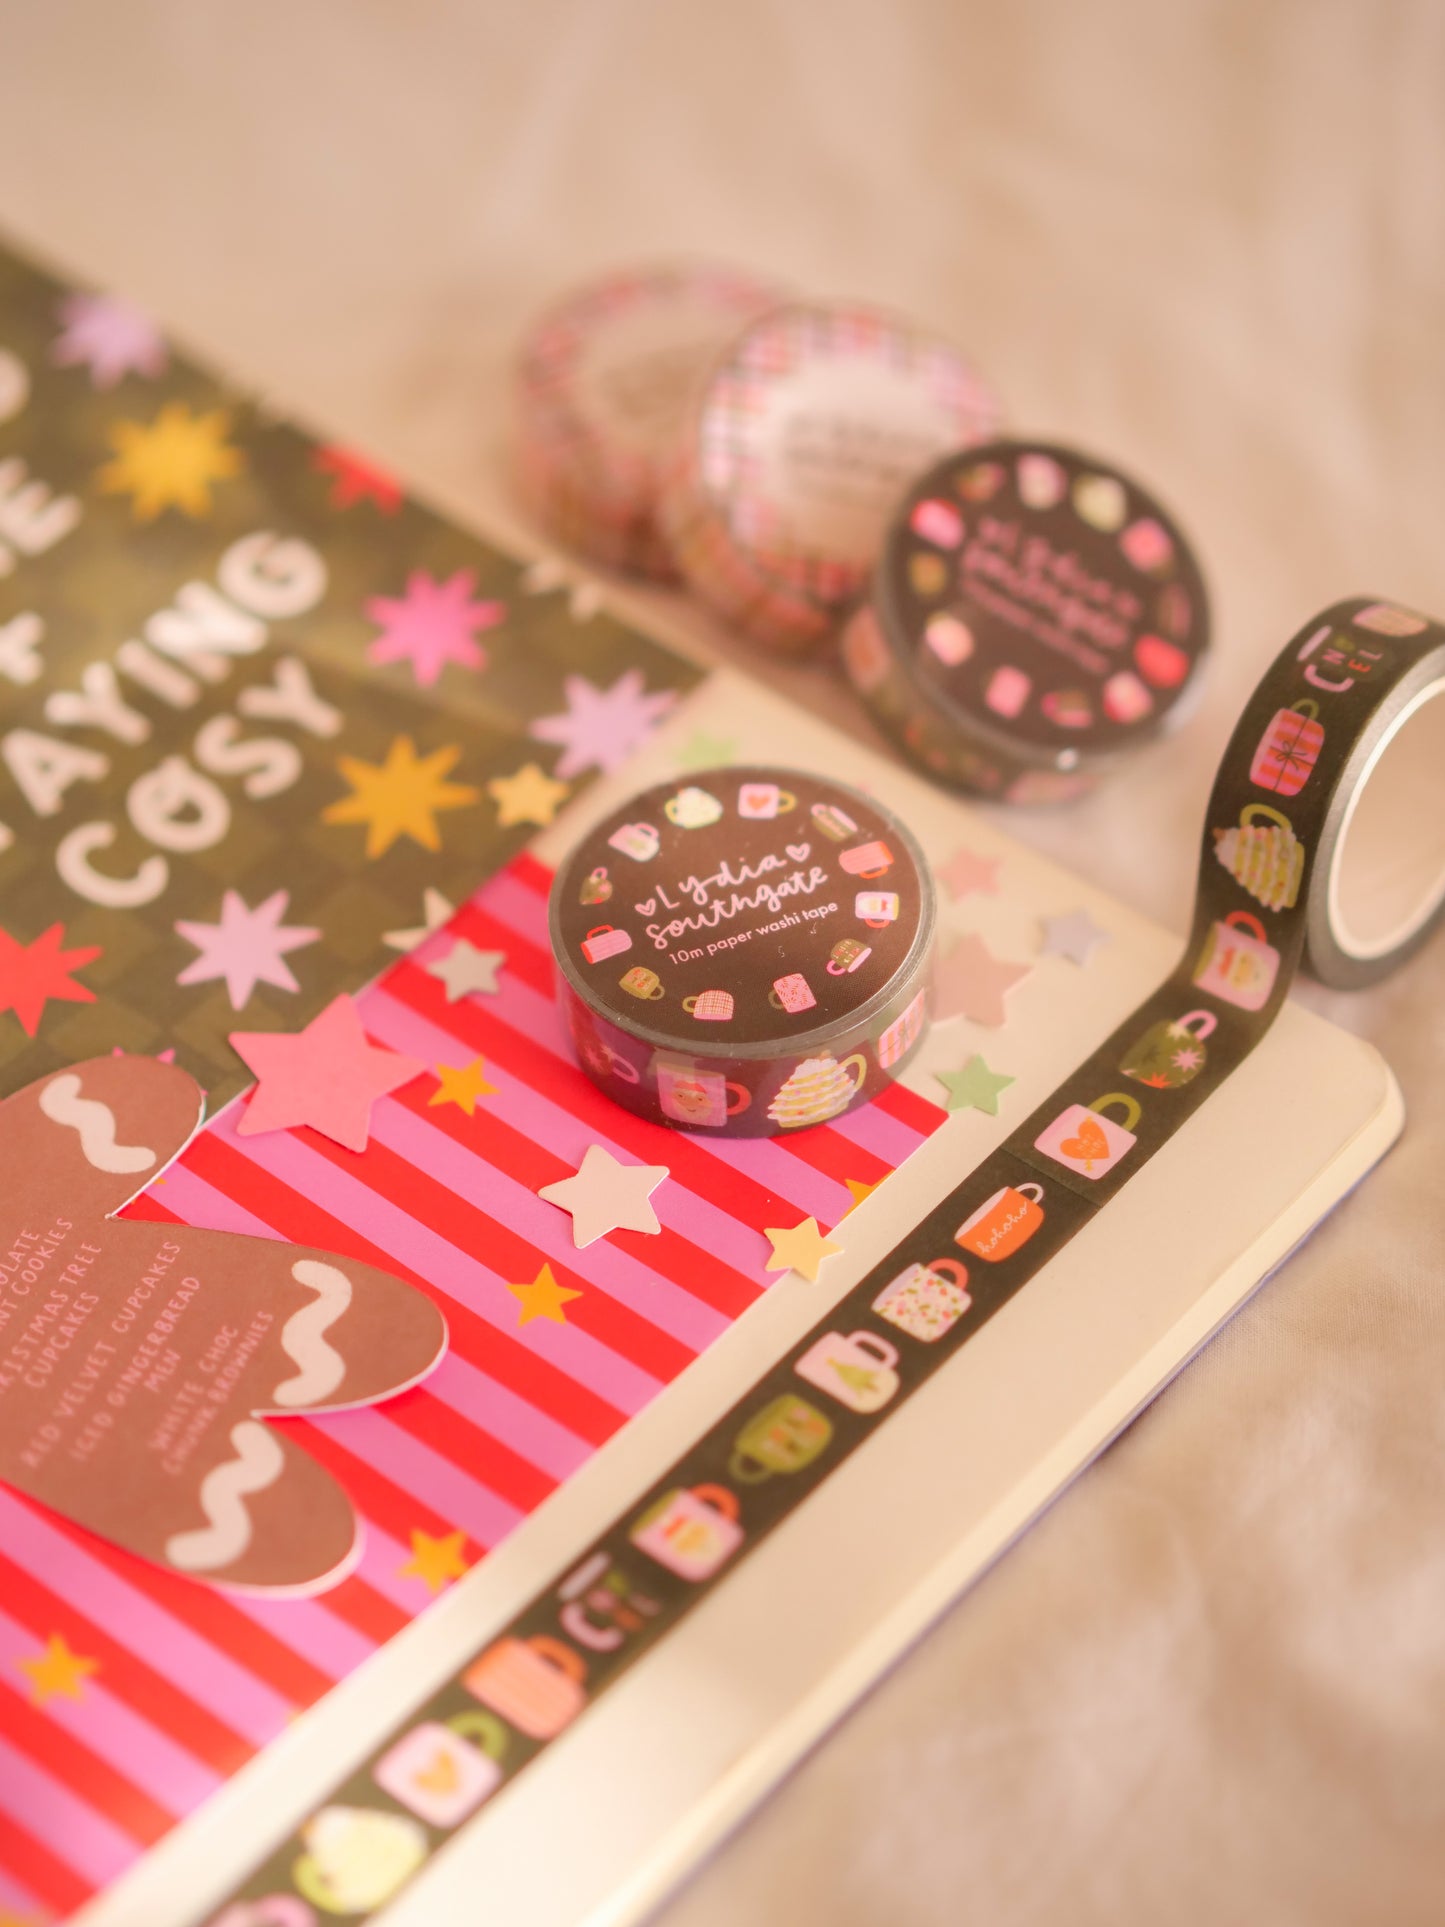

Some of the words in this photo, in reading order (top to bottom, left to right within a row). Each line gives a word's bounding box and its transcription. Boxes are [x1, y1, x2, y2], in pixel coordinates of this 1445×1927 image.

[0, 530, 328, 852] AYING
[56, 655, 344, 908] COSY
[645, 866, 828, 949] southgate
[655, 855, 788, 905] Lydia
[669, 948, 704, 965] 10m
[706, 930, 753, 957] paper
[755, 912, 801, 936] washi
[801, 902, 839, 924] tape
[0, 1229, 40, 1286] OLATE
[11, 1218, 73, 1295] COOKIES
[976, 1200, 1027, 1254] hohoho
[0, 1289, 69, 1392] RISTMAS
[58, 1242, 102, 1286] TREE
[24, 1291, 100, 1389] CUPCAKES
[52, 1340, 118, 1419] VELVET
[111, 1241, 181, 1333] CUPCAKES
[106, 1275, 201, 1408] GINGERBREAD
[207, 1310, 274, 1404] BROWNIES
[144, 1349, 182, 1393] MEN
[150, 1379, 206, 1451] WHITE
[198, 1325, 239, 1374] CHOC
